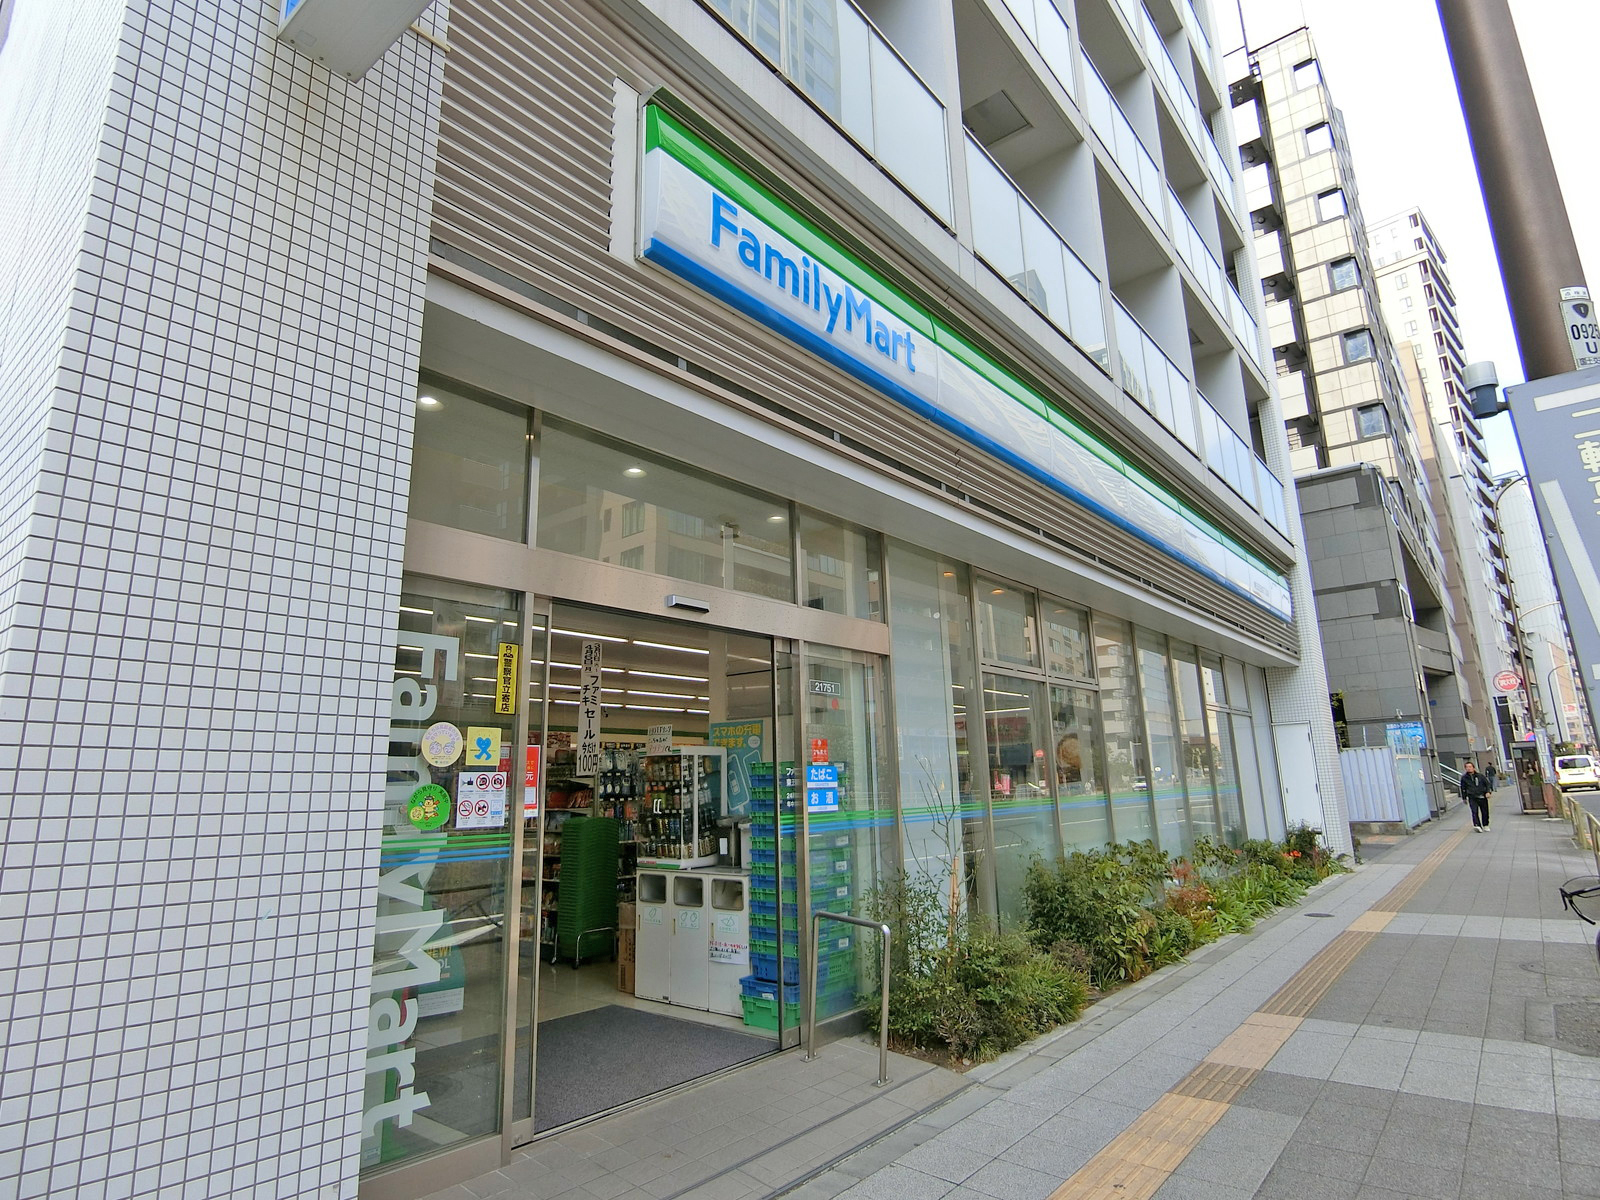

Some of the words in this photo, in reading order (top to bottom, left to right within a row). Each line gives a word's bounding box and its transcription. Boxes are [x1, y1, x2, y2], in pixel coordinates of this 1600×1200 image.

[710, 190, 916, 373] FamilyMart
[1585, 341, 1598, 354] U
[501, 658, 512, 712] 警察官立寄店
[815, 682, 835, 693] 21751
[713, 724, 761, 737] スマホの充電
[810, 768, 833, 780] たばこ
